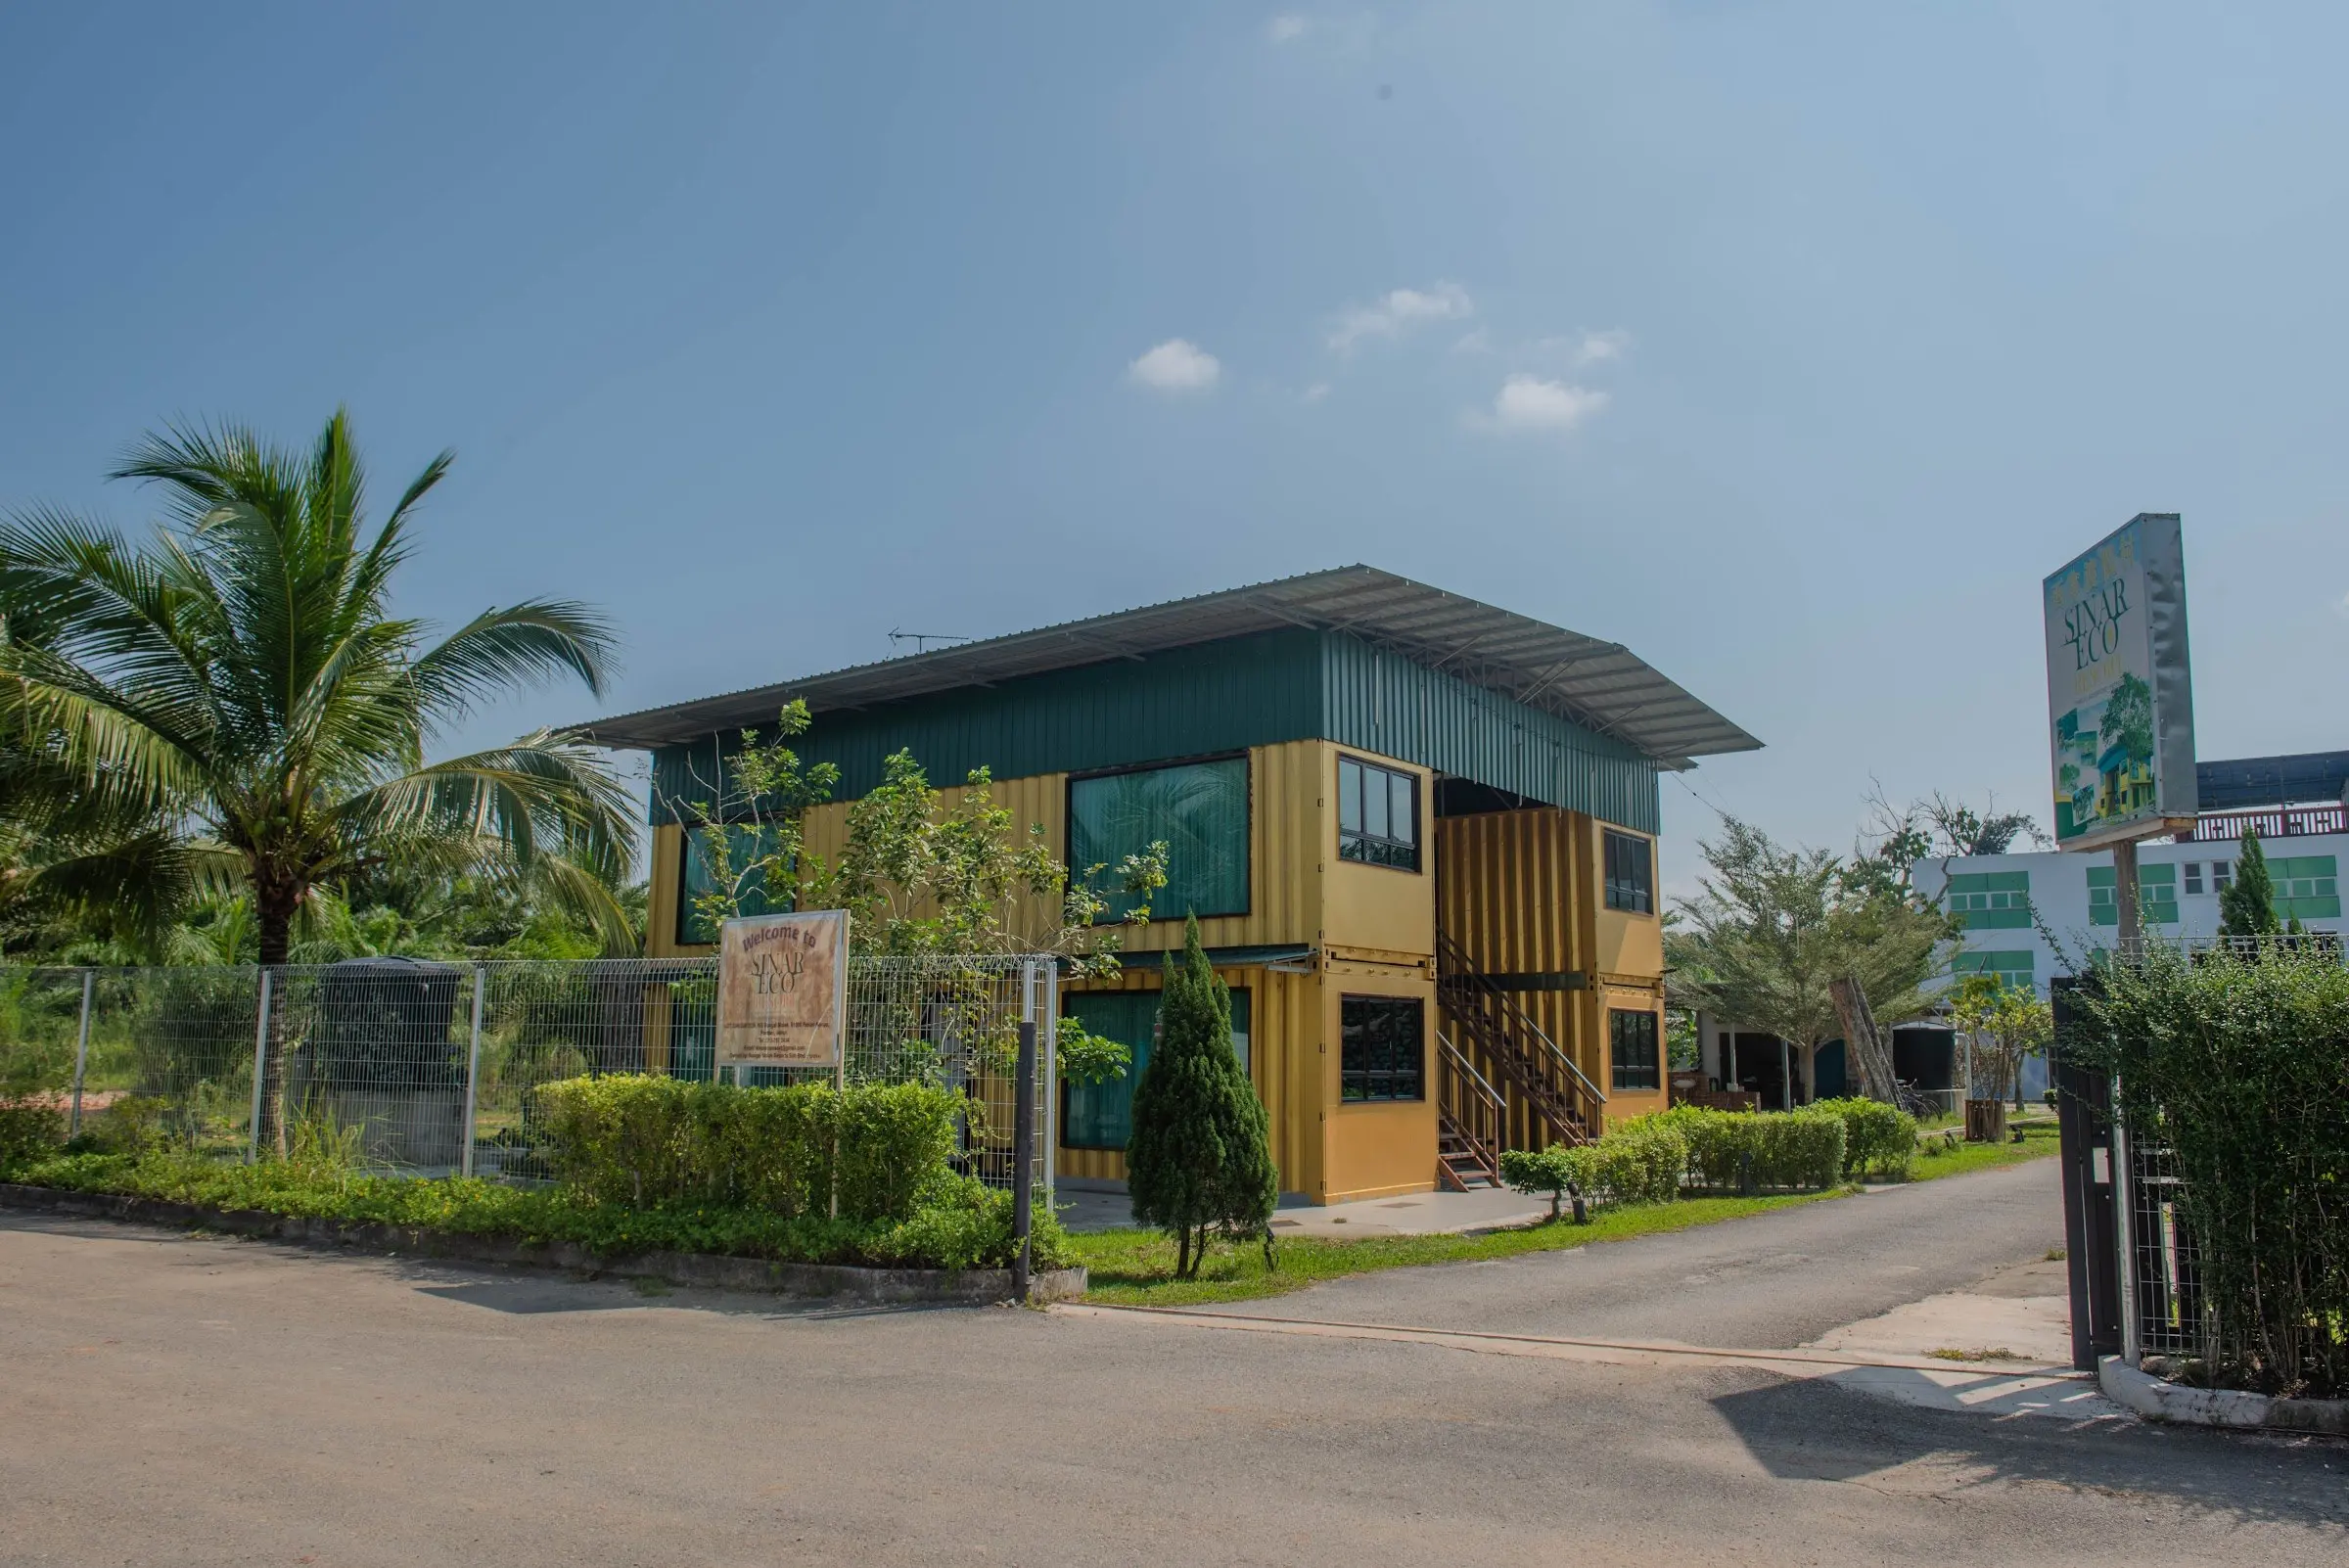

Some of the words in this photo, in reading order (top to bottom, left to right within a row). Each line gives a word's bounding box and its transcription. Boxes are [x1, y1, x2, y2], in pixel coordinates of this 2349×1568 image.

[2060, 577, 2132, 646] SINAR
[2076, 618, 2119, 670] ECO
[743, 925, 800, 952] Welcome
[803, 931, 817, 948] to
[751, 951, 805, 976] SINAR
[758, 972, 796, 994] ECO
